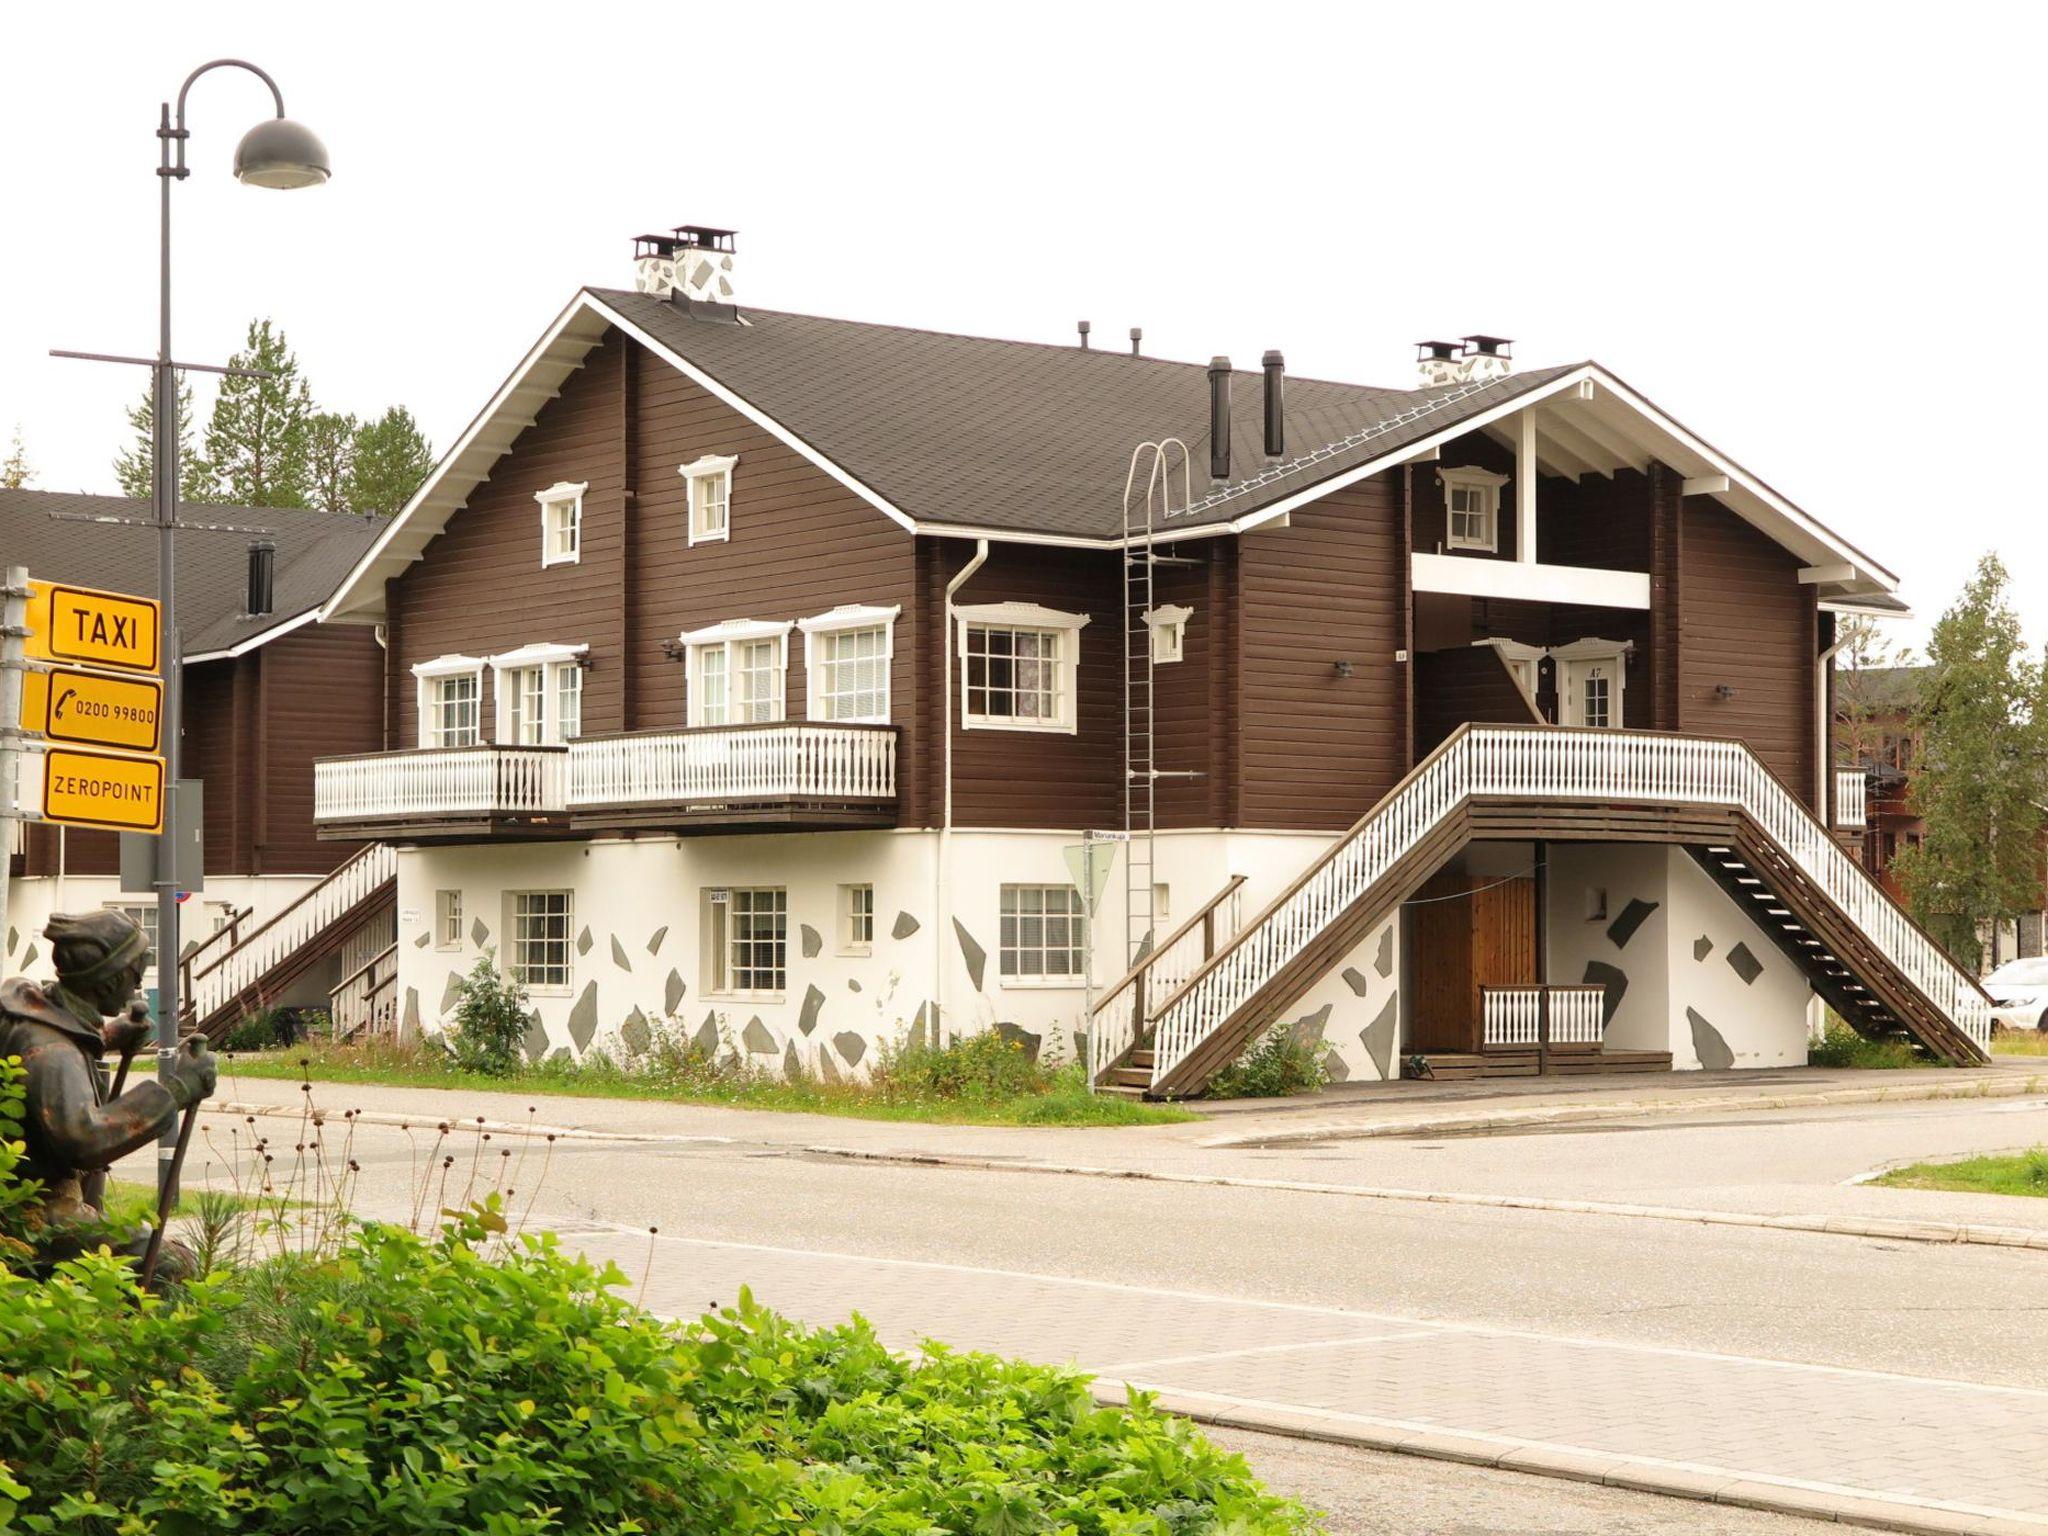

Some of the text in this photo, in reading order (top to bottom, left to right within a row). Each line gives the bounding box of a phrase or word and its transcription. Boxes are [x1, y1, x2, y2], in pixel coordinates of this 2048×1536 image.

[73, 608, 136, 649] TAXI
[76, 700, 154, 724] 0200 99800
[54, 775, 152, 803] ZEROPOINT
